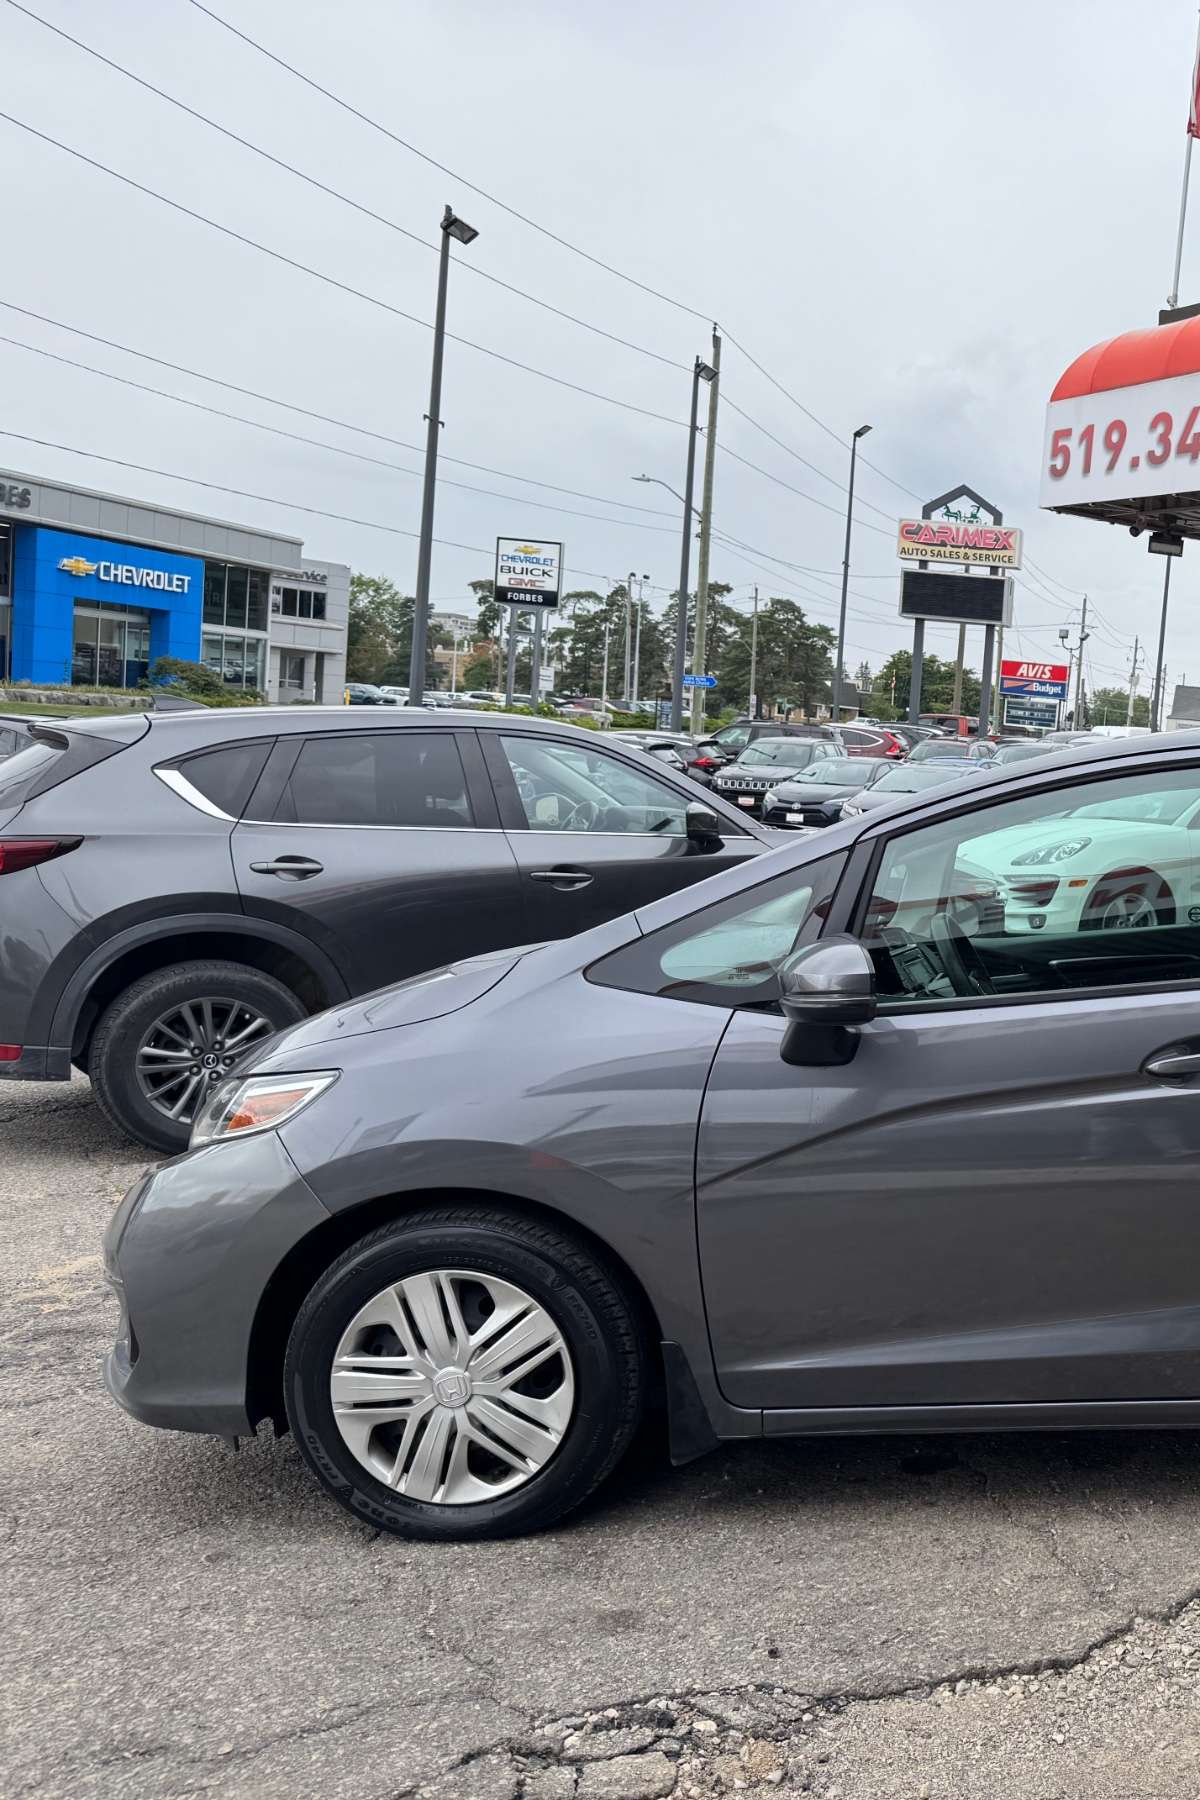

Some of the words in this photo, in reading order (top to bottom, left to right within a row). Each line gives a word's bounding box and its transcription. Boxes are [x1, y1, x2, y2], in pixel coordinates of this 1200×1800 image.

[900, 523, 1017, 549] CARIMEX
[501, 554, 555, 566] CHEVROLET
[900, 547, 928, 557] AUTO
[929, 549, 960, 560] SALES
[962, 552, 970, 561] &
[972, 553, 1014, 564] SERVICE
[99, 561, 192, 593] CHEVROLET
[500, 565, 554, 577] BUICK
[508, 577, 546, 588] GMC
[507, 592, 544, 603] FORBES
[1016, 664, 1053, 679] AVIS
[1033, 682, 1062, 694] Budget
